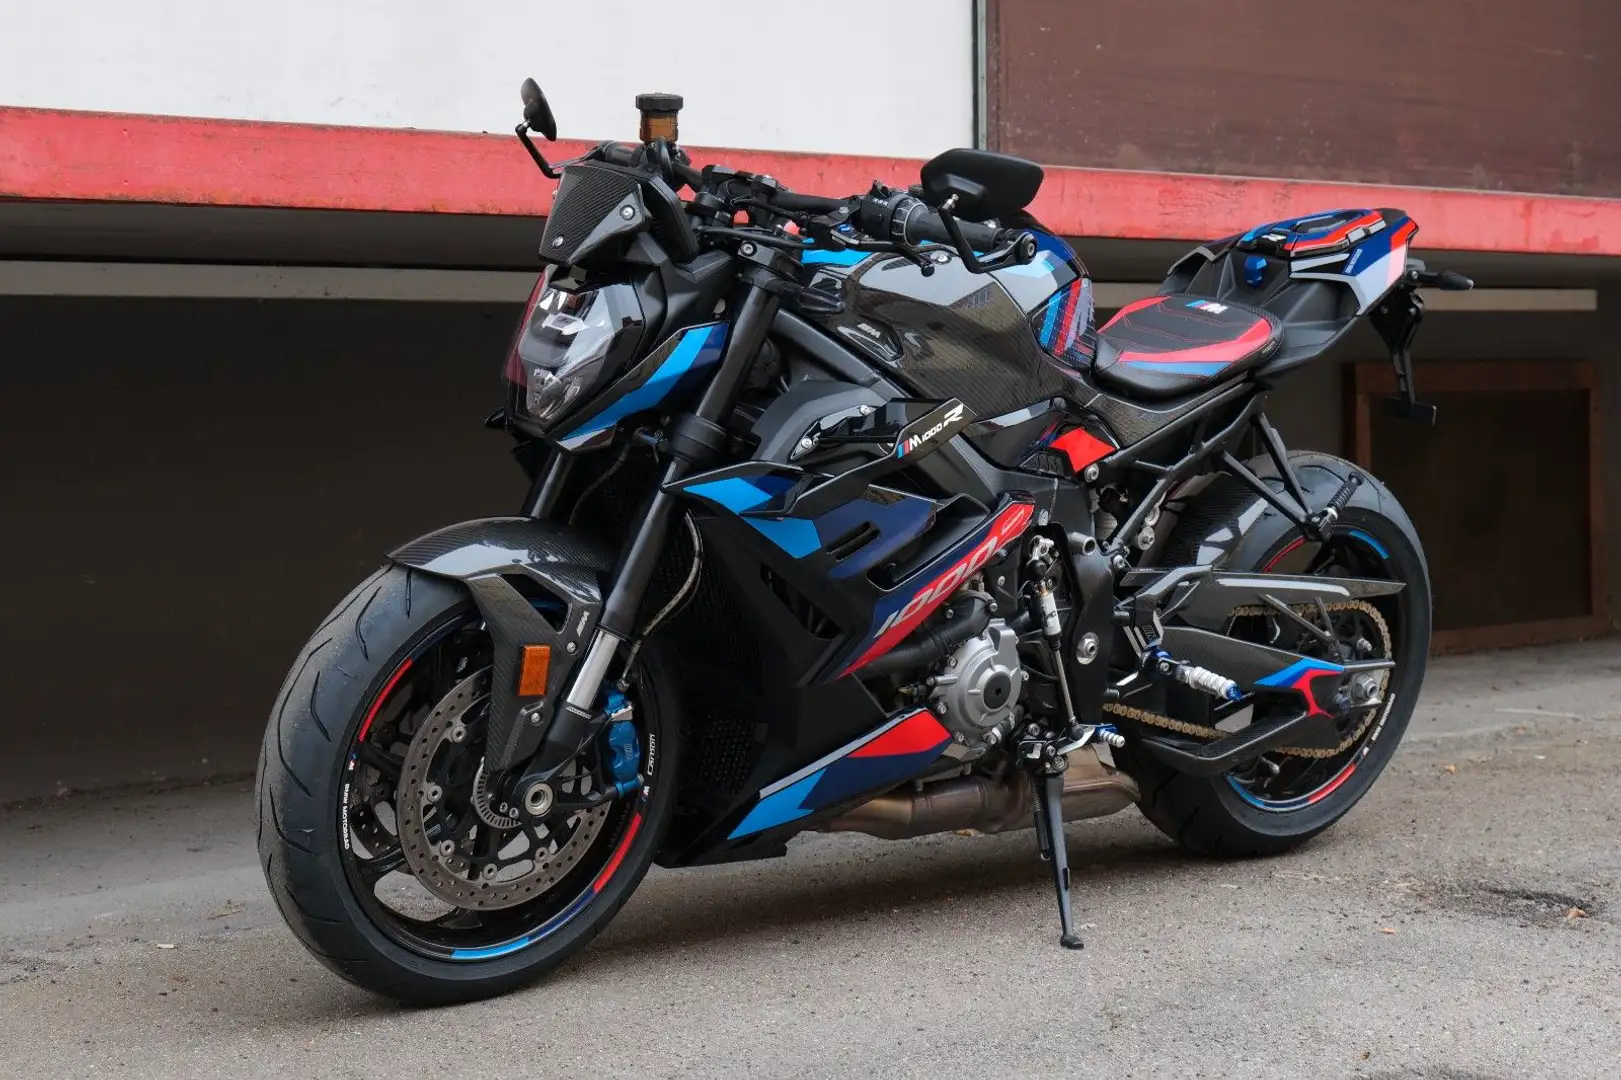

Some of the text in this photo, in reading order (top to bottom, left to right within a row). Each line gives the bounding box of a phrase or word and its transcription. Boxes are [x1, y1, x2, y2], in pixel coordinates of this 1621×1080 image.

[908, 403, 964, 451] M 1000 R
[873, 536, 998, 640] 1000
[342, 805, 350, 850] MOTORRAD
